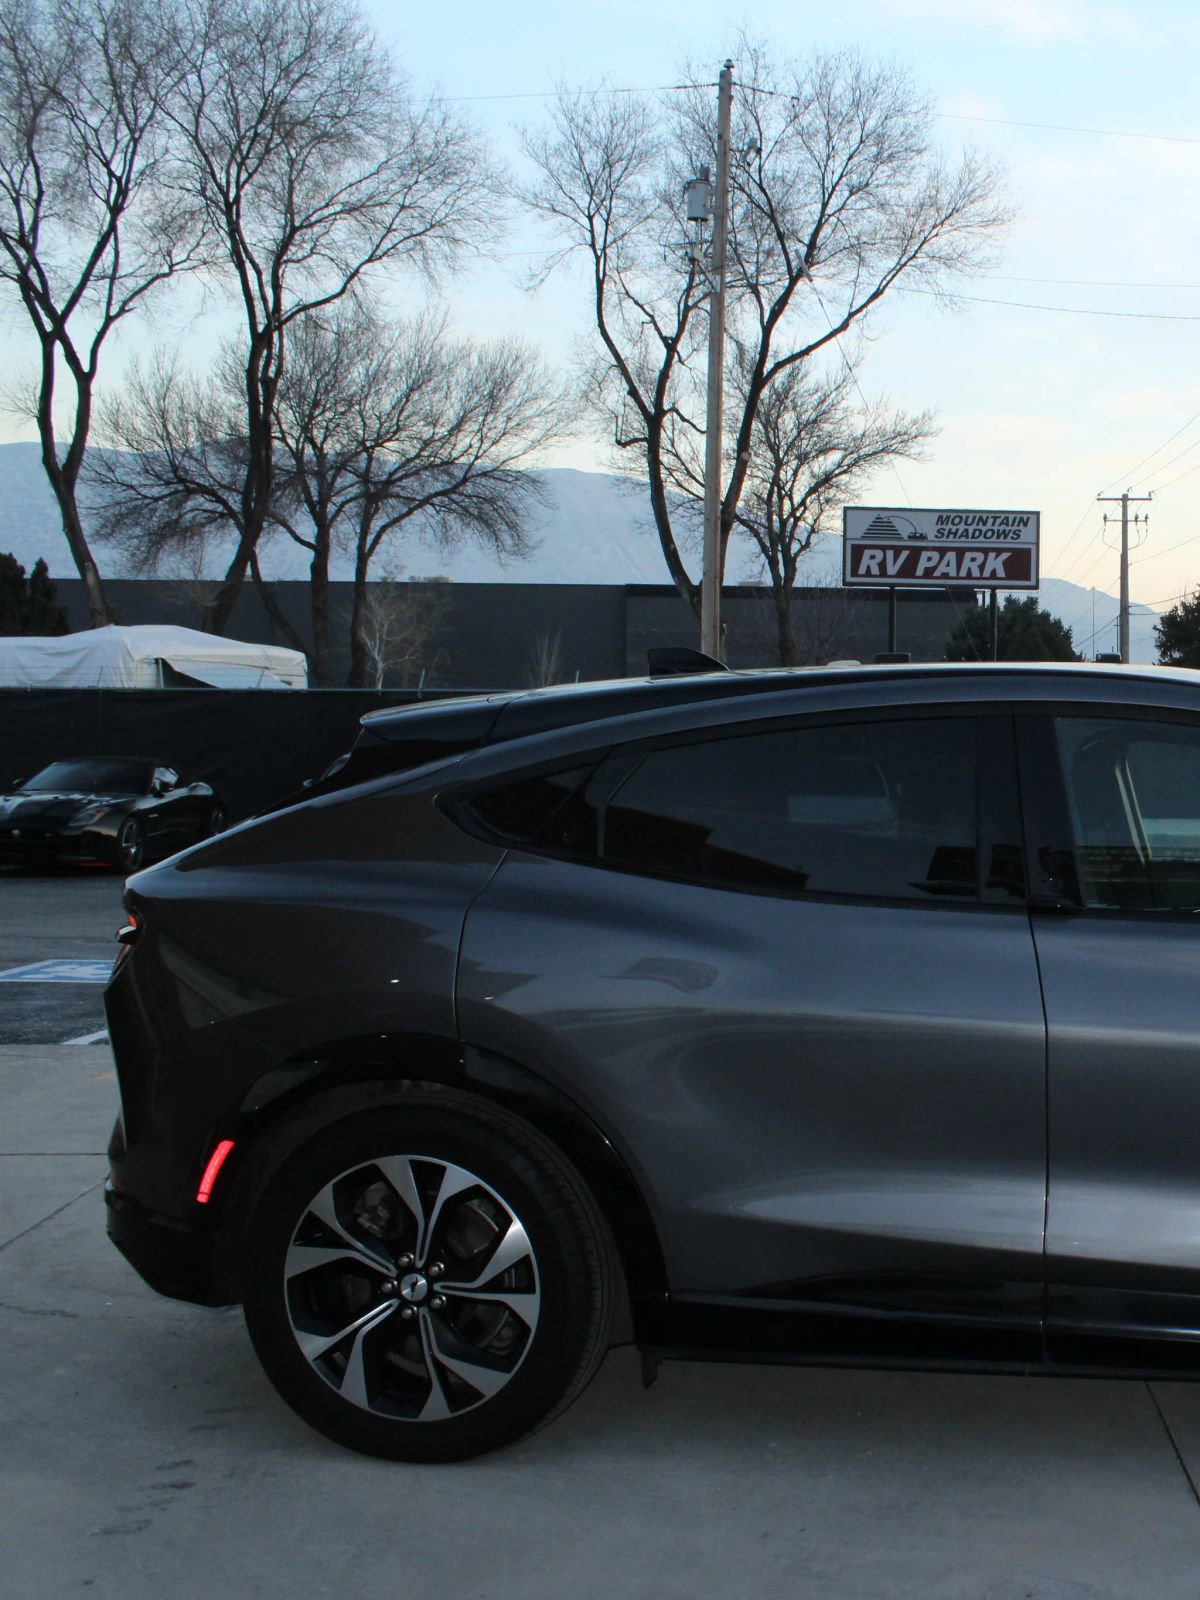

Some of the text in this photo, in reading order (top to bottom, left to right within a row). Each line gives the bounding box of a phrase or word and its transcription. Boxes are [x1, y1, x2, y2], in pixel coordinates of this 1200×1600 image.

[935, 514, 1030, 528] MOUNTAIN
[934, 528, 1022, 541] SHADOWS
[858, 549, 1012, 579] RV PARK
